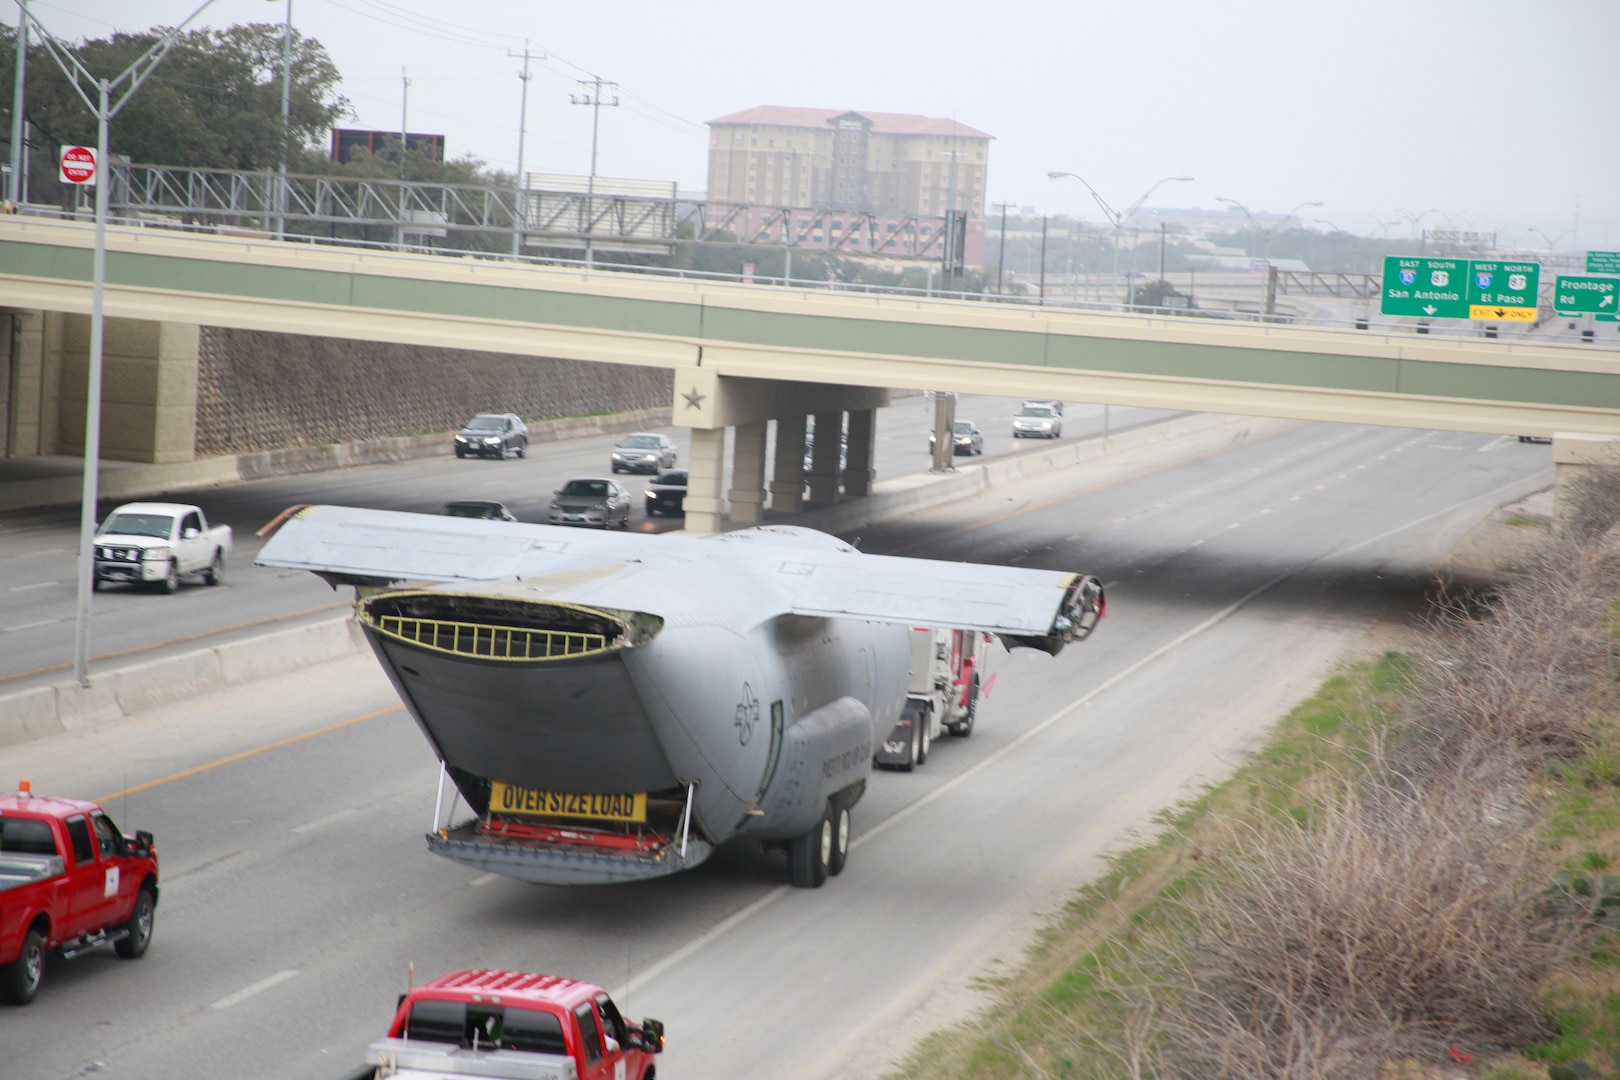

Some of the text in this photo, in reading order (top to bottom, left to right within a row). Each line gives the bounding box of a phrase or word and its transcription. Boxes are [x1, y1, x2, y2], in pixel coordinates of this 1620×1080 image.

[77, 154, 92, 162] NOT
[67, 169, 89, 177] ENTER
[1427, 261, 1456, 269] SOUTH
[1403, 273, 1413, 283] 10
[1433, 273, 1447, 283] 87
[1479, 276, 1489, 286] 10
[1511, 277, 1524, 287] 87
[1561, 280, 1614, 293] Frontage
[1388, 289, 1460, 301] San Antonio
[1481, 293, 1525, 304] El Paso
[1560, 295, 1575, 304] Rd
[590, 792, 634, 817] LOAD
